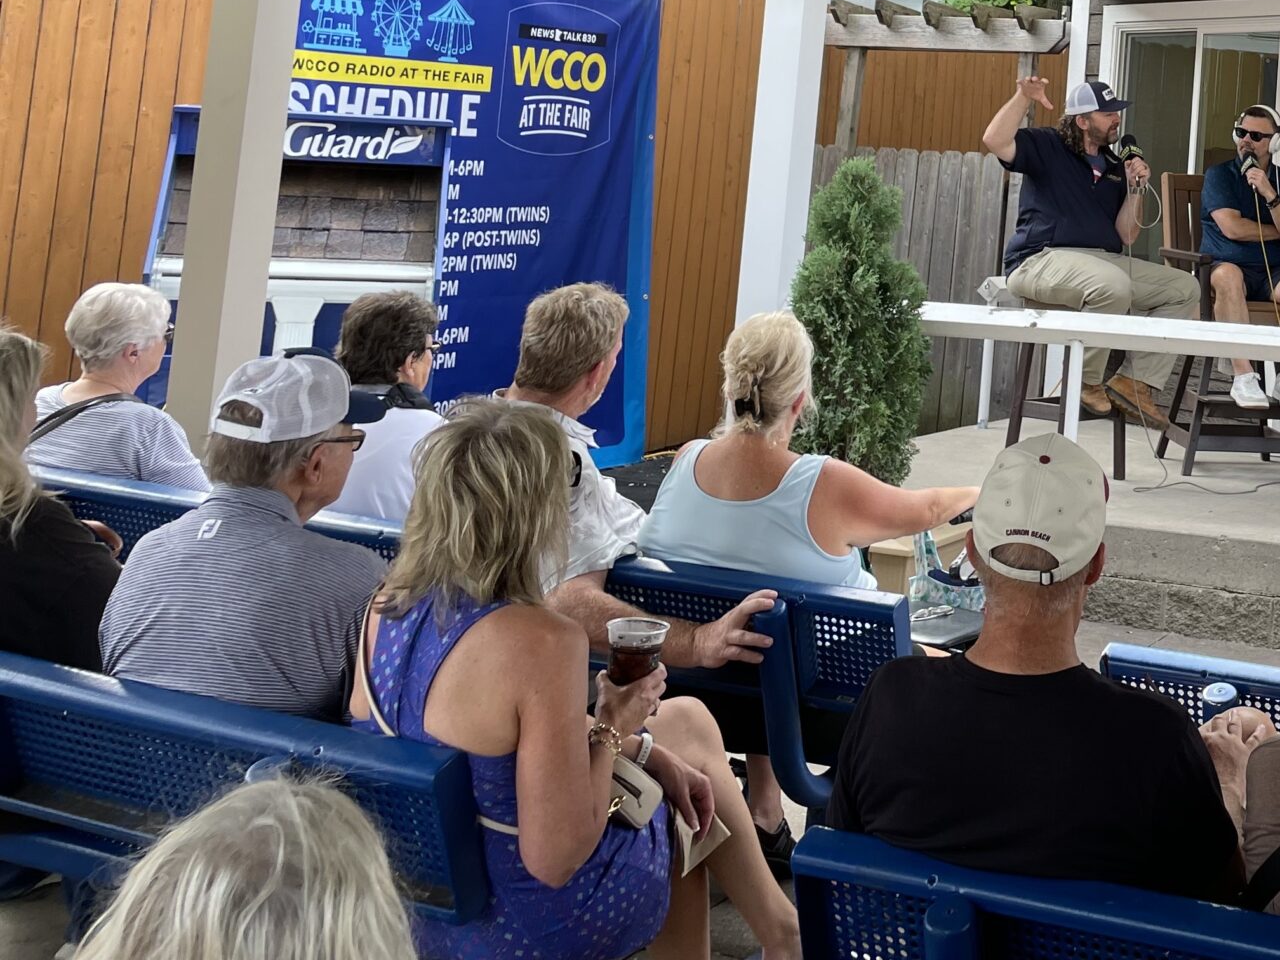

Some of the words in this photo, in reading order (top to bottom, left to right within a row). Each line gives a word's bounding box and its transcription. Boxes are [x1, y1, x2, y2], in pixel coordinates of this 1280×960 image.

[530, 27, 555, 39] NEWS
[563, 31, 581, 42] TALK
[582, 33, 597, 44] 830
[292, 58, 340, 73] WCCO
[345, 63, 396, 79] RADIO
[400, 67, 419, 79] AT
[424, 69, 450, 82] THE
[453, 71, 485, 85] FAIR
[512, 45, 607, 92] WCCO
[288, 81, 481, 137] SCHEDULE
[519, 104, 537, 128] AT
[538, 103, 562, 126] THE
[563, 105, 591, 131] FAIR
[283, 122, 395, 160] Guard
[446, 207, 503, 224] -12:30PM
[506, 206, 550, 225] (TWINS)
[462, 229, 541, 250] (POST-TWINS)
[470, 253, 517, 273] (TWINS)
[1030, 530, 1051, 542] BEACH
